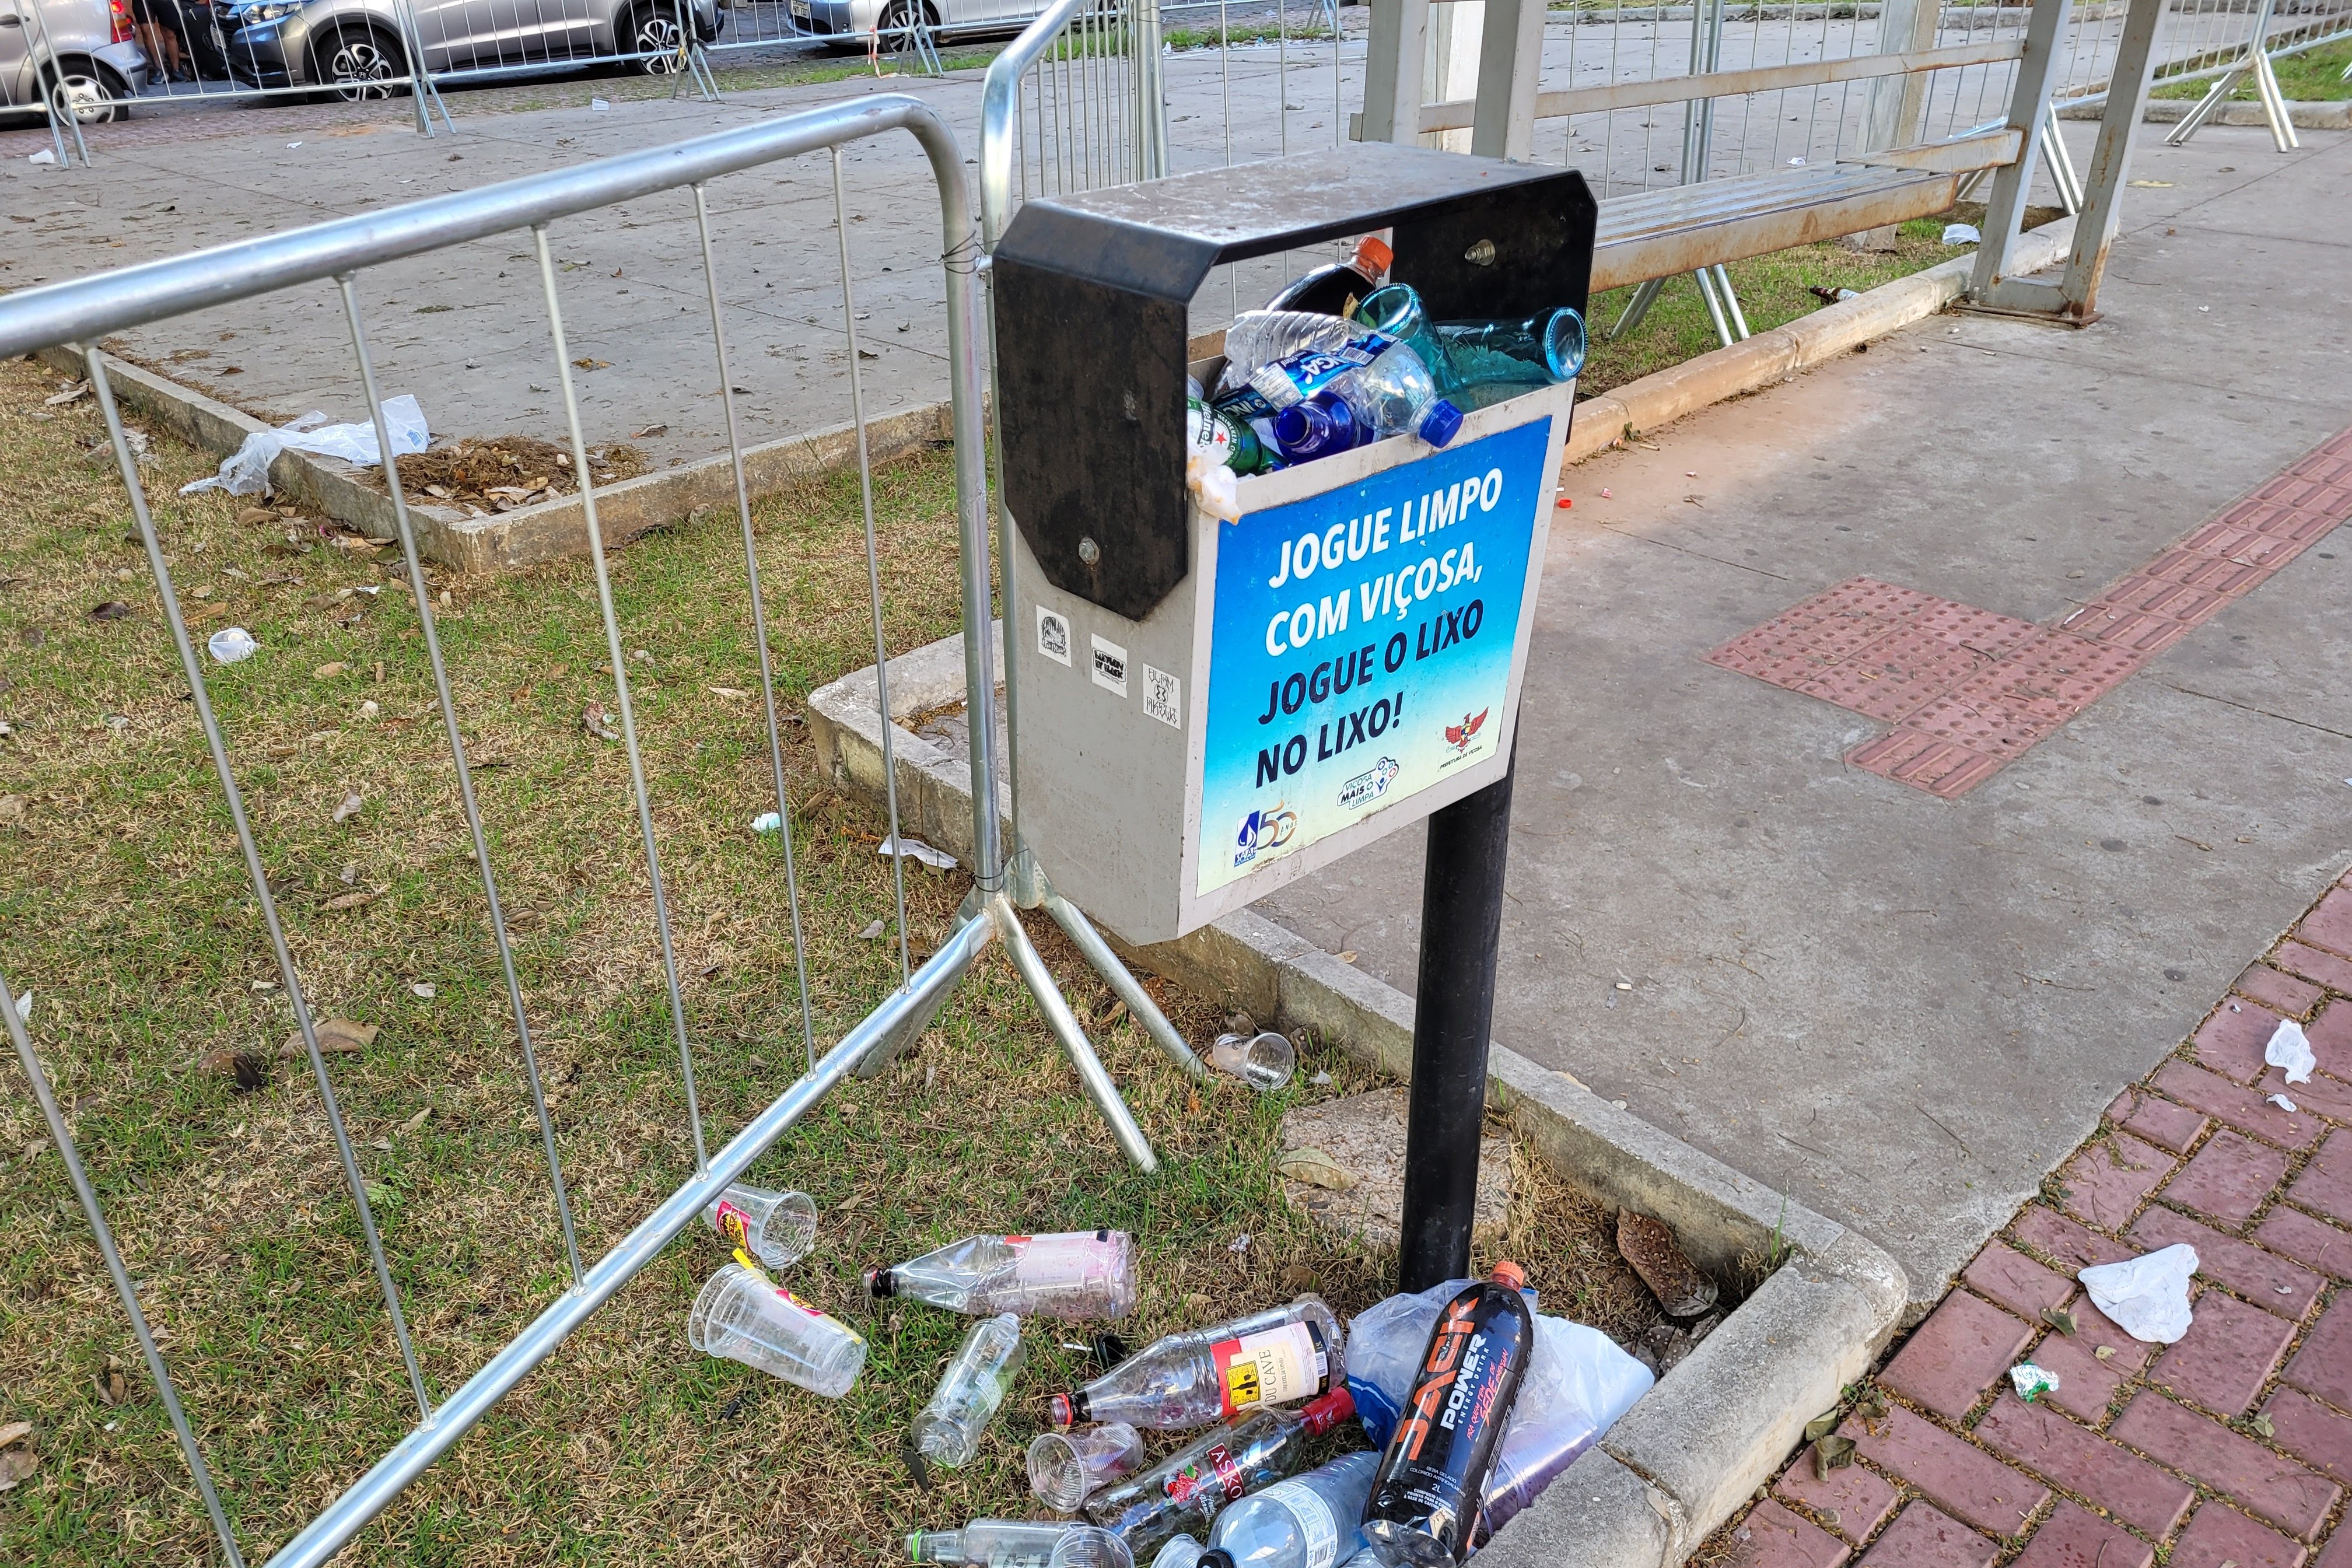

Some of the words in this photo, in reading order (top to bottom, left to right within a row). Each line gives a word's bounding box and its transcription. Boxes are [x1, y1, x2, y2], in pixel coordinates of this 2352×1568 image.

[1217, 413, 1237, 444] HEINEKEN
[1268, 506, 1390, 590] JOGUE
[1400, 468, 1503, 542] LIMPO
[1265, 589, 1350, 657] COM
[1359, 542, 1484, 622] VIÇOSA,
[1095, 659, 1103, 670] BY
[1104, 663, 1124, 680] BLACK
[1258, 645, 1376, 726] JOGUE
[1384, 631, 1407, 673] O
[1415, 598, 1484, 662] LIXO
[1255, 734, 1306, 788] NO
[1317, 692, 1402, 763] LIXO!
[1440, 755, 1461, 769] PREFEITURA
[1340, 785, 1364, 804] MAIS
[1346, 774, 1372, 791] VIÇOSA
[1352, 791, 1374, 807] LIMPA
[1280, 820, 1297, 834] ANOS
[1259, 1349, 1276, 1385] CAVE
[1396, 1297, 1479, 1461] JACK
[1440, 1334, 1487, 1431] POWER
[1489, 1360, 1496, 1374] DE
[1265, 1388, 1277, 1402] DU
[1458, 1383, 1476, 1425] ENERGY
[1474, 1348, 1489, 1380] DRINK
[1479, 1376, 1497, 1421] SEDE
[1466, 1424, 1476, 1441] PRA
[1471, 1402, 1480, 1424] QUEM
[1477, 1384, 1486, 1401] TEM
[1409, 1467, 1433, 1478] COLORIDO
[1433, 1474, 1467, 1499] ARTIFICIALMENTE
[1426, 1466, 1439, 1474] BEBA
[1439, 1471, 1458, 1483] GELADO
[1432, 1483, 1442, 1494] 2L
[1424, 1495, 1434, 1504] PARA
